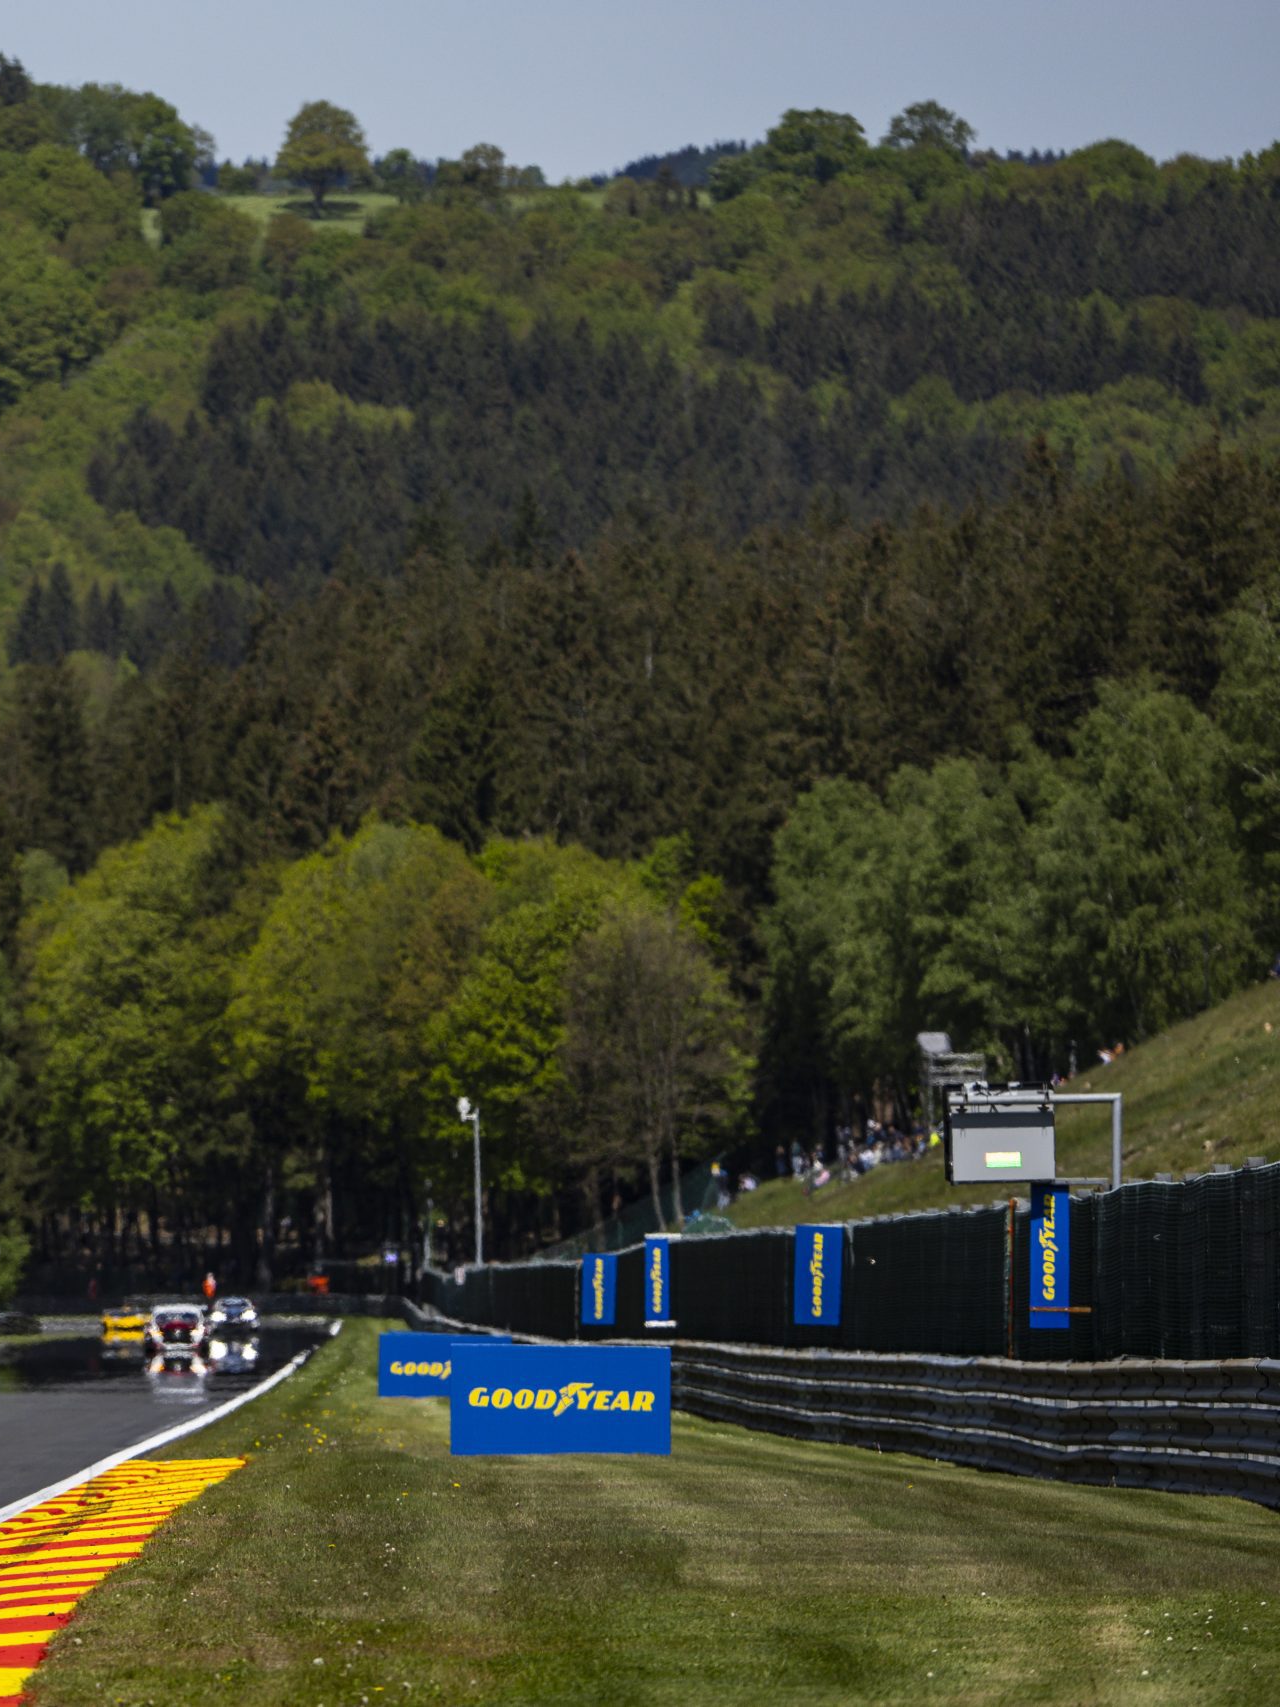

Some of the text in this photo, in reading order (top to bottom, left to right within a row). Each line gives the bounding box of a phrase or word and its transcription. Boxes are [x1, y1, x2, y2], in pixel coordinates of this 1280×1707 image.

[810, 1232, 825, 1318] GOODYEAR
[1038, 1194, 1059, 1301] GOODYEAR
[468, 1382, 656, 1417] GOODYEAR
